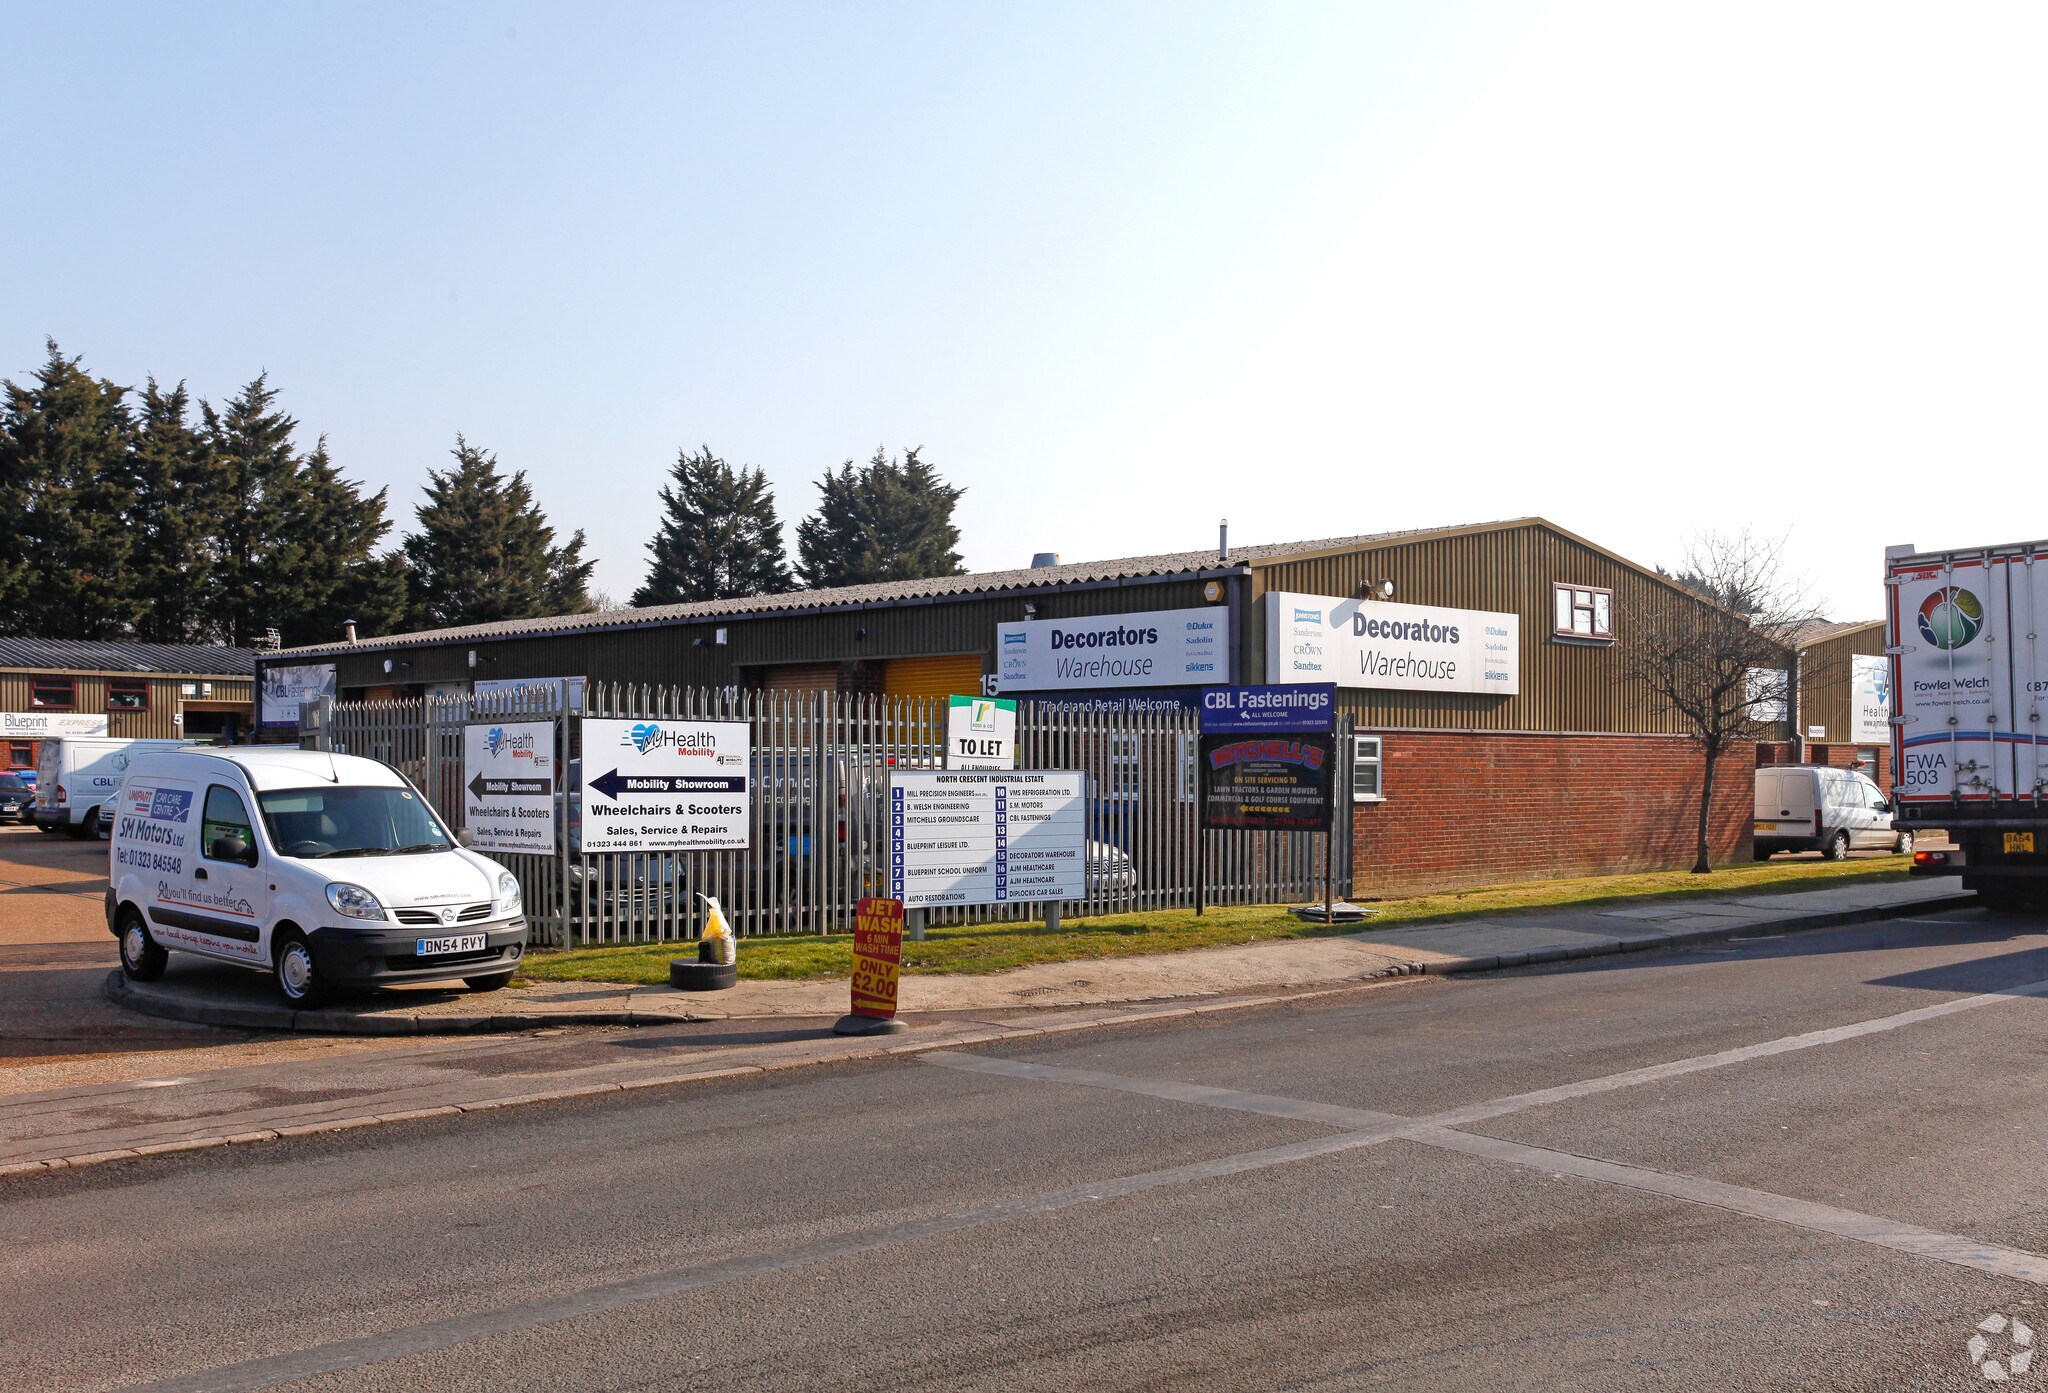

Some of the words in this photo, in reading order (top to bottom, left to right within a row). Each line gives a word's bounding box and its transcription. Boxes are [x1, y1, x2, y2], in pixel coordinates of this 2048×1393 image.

[1192, 622, 1213, 630] Dulux
[1353, 611, 1460, 644] Decorators
[1051, 626, 1158, 650] Decorators
[1294, 644, 1322, 655] CROWN
[1056, 654, 1153, 679] Warehouse
[1186, 663, 1213, 671] sikkens
[1294, 660, 1322, 670] Sandtex
[1360, 650, 1456, 680] Warehouse
[1485, 670, 1508, 680] sikkens
[980, 674, 1000, 696] 15
[1954, 677, 1990, 688] Welch
[1095, 698, 1125, 712] Retail
[1128, 698, 1180, 711] Welcome
[1204, 692, 1235, 709] CBL
[1239, 690, 1328, 710] Fastenings
[5, 714, 48, 730] Blueprint
[174, 714, 182, 724] 5
[678, 748, 715, 757] Mobility
[960, 739, 977, 754] TO
[980, 740, 1002, 756] LET
[512, 750, 533, 759] Mobility
[1210, 740, 1324, 768] MITCHELL'S
[1906, 754, 1946, 769] FWA
[1906, 770, 1938, 784] 503
[486, 782, 509, 793] Mobility
[511, 783, 542, 792] Showroom
[627, 779, 669, 791] Mobility
[675, 779, 729, 789] Showroom
[128, 790, 153, 803] UNIPART
[895, 789, 900, 797] 1
[997, 788, 1005, 796] 10
[156, 793, 167, 804] CAR
[167, 794, 182, 805] CARE
[153, 804, 173, 816] CENTRE
[591, 805, 671, 816] Wheelchairs
[675, 804, 684, 815] &
[688, 804, 742, 815] Scooters
[896, 802, 900, 810] 2
[997, 801, 1005, 809] 11
[469, 806, 510, 818] Wheelchairs
[511, 807, 517, 818] &
[518, 807, 550, 819] Scooters
[997, 814, 1005, 822] 12
[896, 816, 900, 824] 3
[120, 817, 135, 838] SM
[135, 820, 173, 845] Motors
[173, 833, 185, 846] Ltd
[476, 827, 493, 837] Sales,
[494, 828, 514, 837] Service
[515, 828, 519, 836] &
[520, 829, 542, 839] Repairs
[606, 826, 638, 837] Sales,
[641, 826, 678, 835] Service
[681, 826, 688, 834] &
[691, 825, 728, 835] Repairs
[895, 829, 900, 837] 4
[997, 826, 1005, 834] 13
[498, 842, 552, 850] www.myhealthmobility.co.uk
[648, 838, 745, 847] www.myhealthmobility.co.uk
[896, 842, 900, 850] 5
[997, 839, 1005, 847] 14
[117, 847, 127, 864] Tel:
[129, 849, 151, 869] 01323
[153, 854, 182, 874] 845548
[896, 855, 900, 863] 6
[997, 852, 1005, 860] 15
[896, 869, 900, 877] 7
[997, 864, 1005, 873] 16
[896, 882, 900, 890] 8
[997, 877, 1005, 885] 17
[169, 888, 186, 900] you'll
[188, 890, 202, 900] find
[203, 893, 212, 904] us
[997, 890, 1006, 898] 18
[866, 900, 895, 916] JET
[858, 916, 902, 933] WASH
[426, 939, 457, 953] DN54
[462, 936, 484, 950] RVY
[874, 934, 888, 944] MIN
[856, 943, 878, 953] WASH
[880, 945, 899, 955] TIME
[860, 959, 893, 978] ONLY
[852, 972, 896, 998] £2.00
